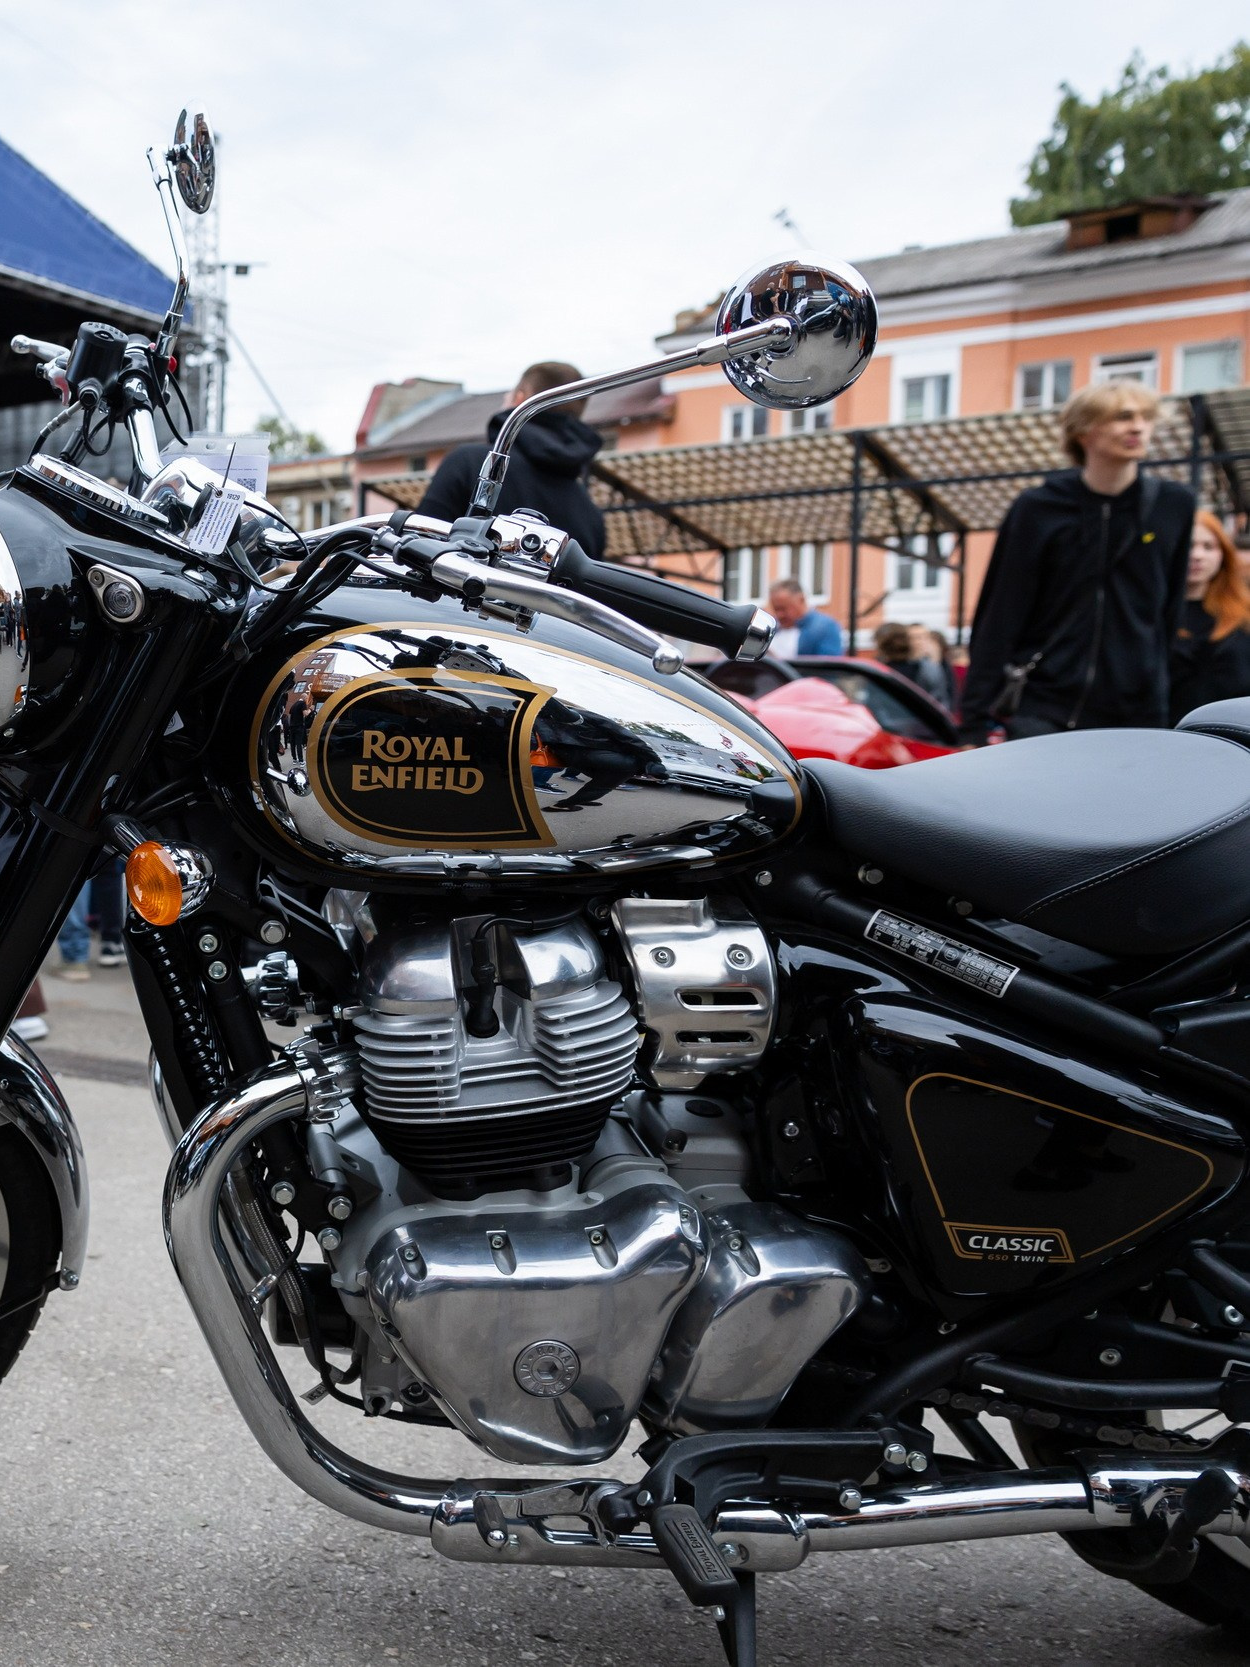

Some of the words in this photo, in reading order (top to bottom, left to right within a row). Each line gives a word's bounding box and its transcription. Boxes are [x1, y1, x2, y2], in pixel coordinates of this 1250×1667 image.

[362, 730, 470, 763] ROYAL
[351, 765, 484, 795] ENFIELD
[968, 1235, 1054, 1253] CLASSIC
[1013, 1255, 1045, 1263] TWIN
[681, 1522, 704, 1549] ENFIELD
[697, 1549, 718, 1573] ROYAL
